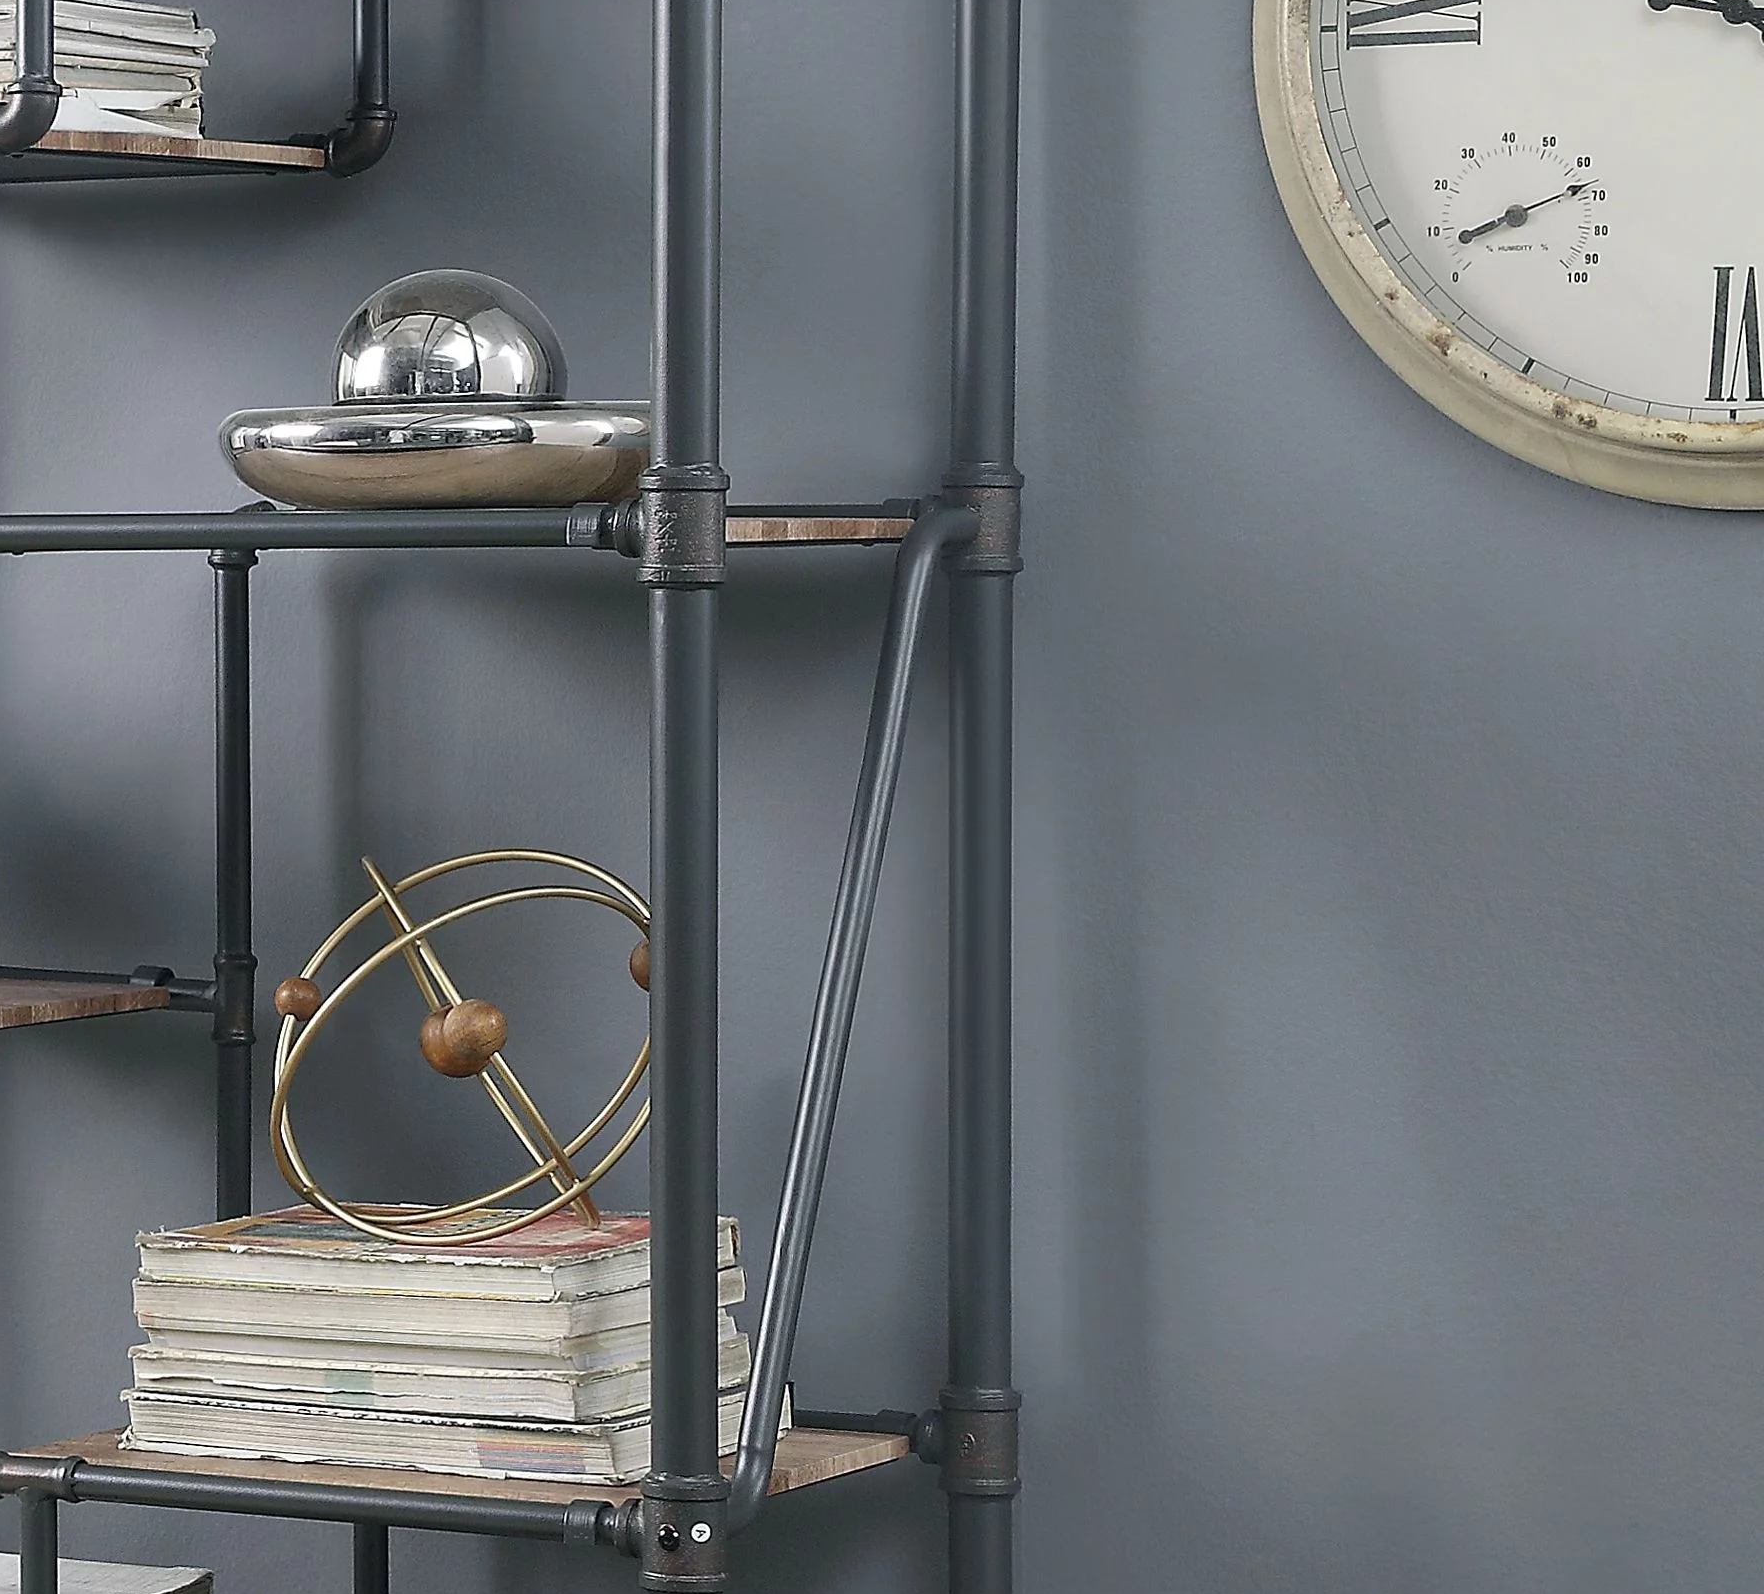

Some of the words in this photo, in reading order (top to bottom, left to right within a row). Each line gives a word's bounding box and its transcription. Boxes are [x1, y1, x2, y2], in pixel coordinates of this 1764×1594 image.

[1501, 132, 1516, 144] 40
[1542, 136, 1557, 147] 50
[1461, 148, 1475, 159] 30
[1576, 156, 1591, 168] 60
[1434, 179, 1448, 191] 20
[1591, 190, 1606, 201] 70
[1427, 226, 1440, 237] 10
[1594, 225, 1608, 236] 80
[1584, 253, 1599, 265] 90
[1452, 272, 1459, 283] 0
[1567, 272, 1588, 283] 100
